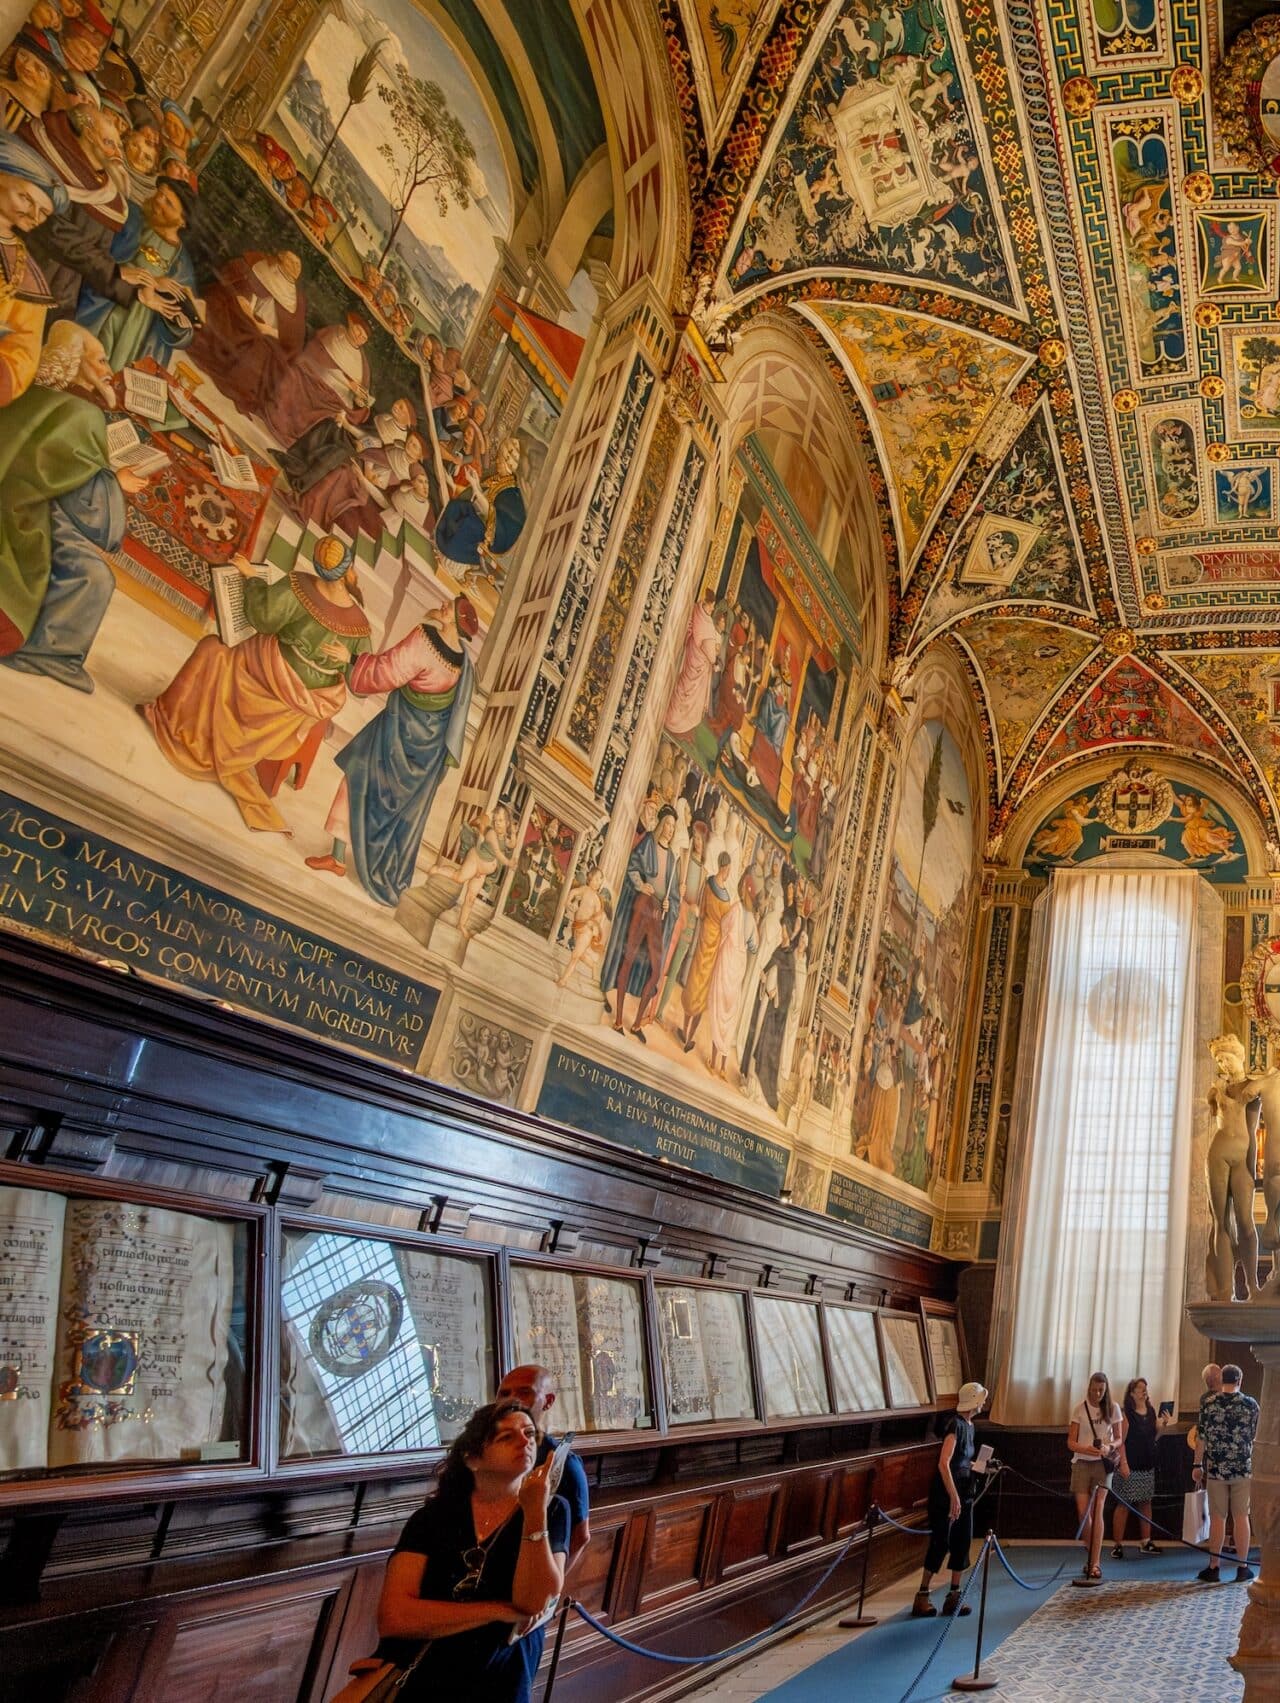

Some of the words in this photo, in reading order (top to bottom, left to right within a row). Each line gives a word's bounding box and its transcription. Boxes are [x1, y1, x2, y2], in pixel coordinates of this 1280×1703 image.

[45, 899, 151, 957] TVRCOS
[159, 946, 300, 1013] CONVENTVM
[216, 935, 287, 978] IVNIAS
[295, 967, 392, 1020] MANTVAM
[396, 1012, 423, 1031] AD
[252, 919, 337, 968] PRINCIPE
[344, 960, 400, 997] CLASSE
[404, 986, 422, 1005] IN
[606, 1097, 622, 1114] RA
[626, 1104, 648, 1124] EIVS
